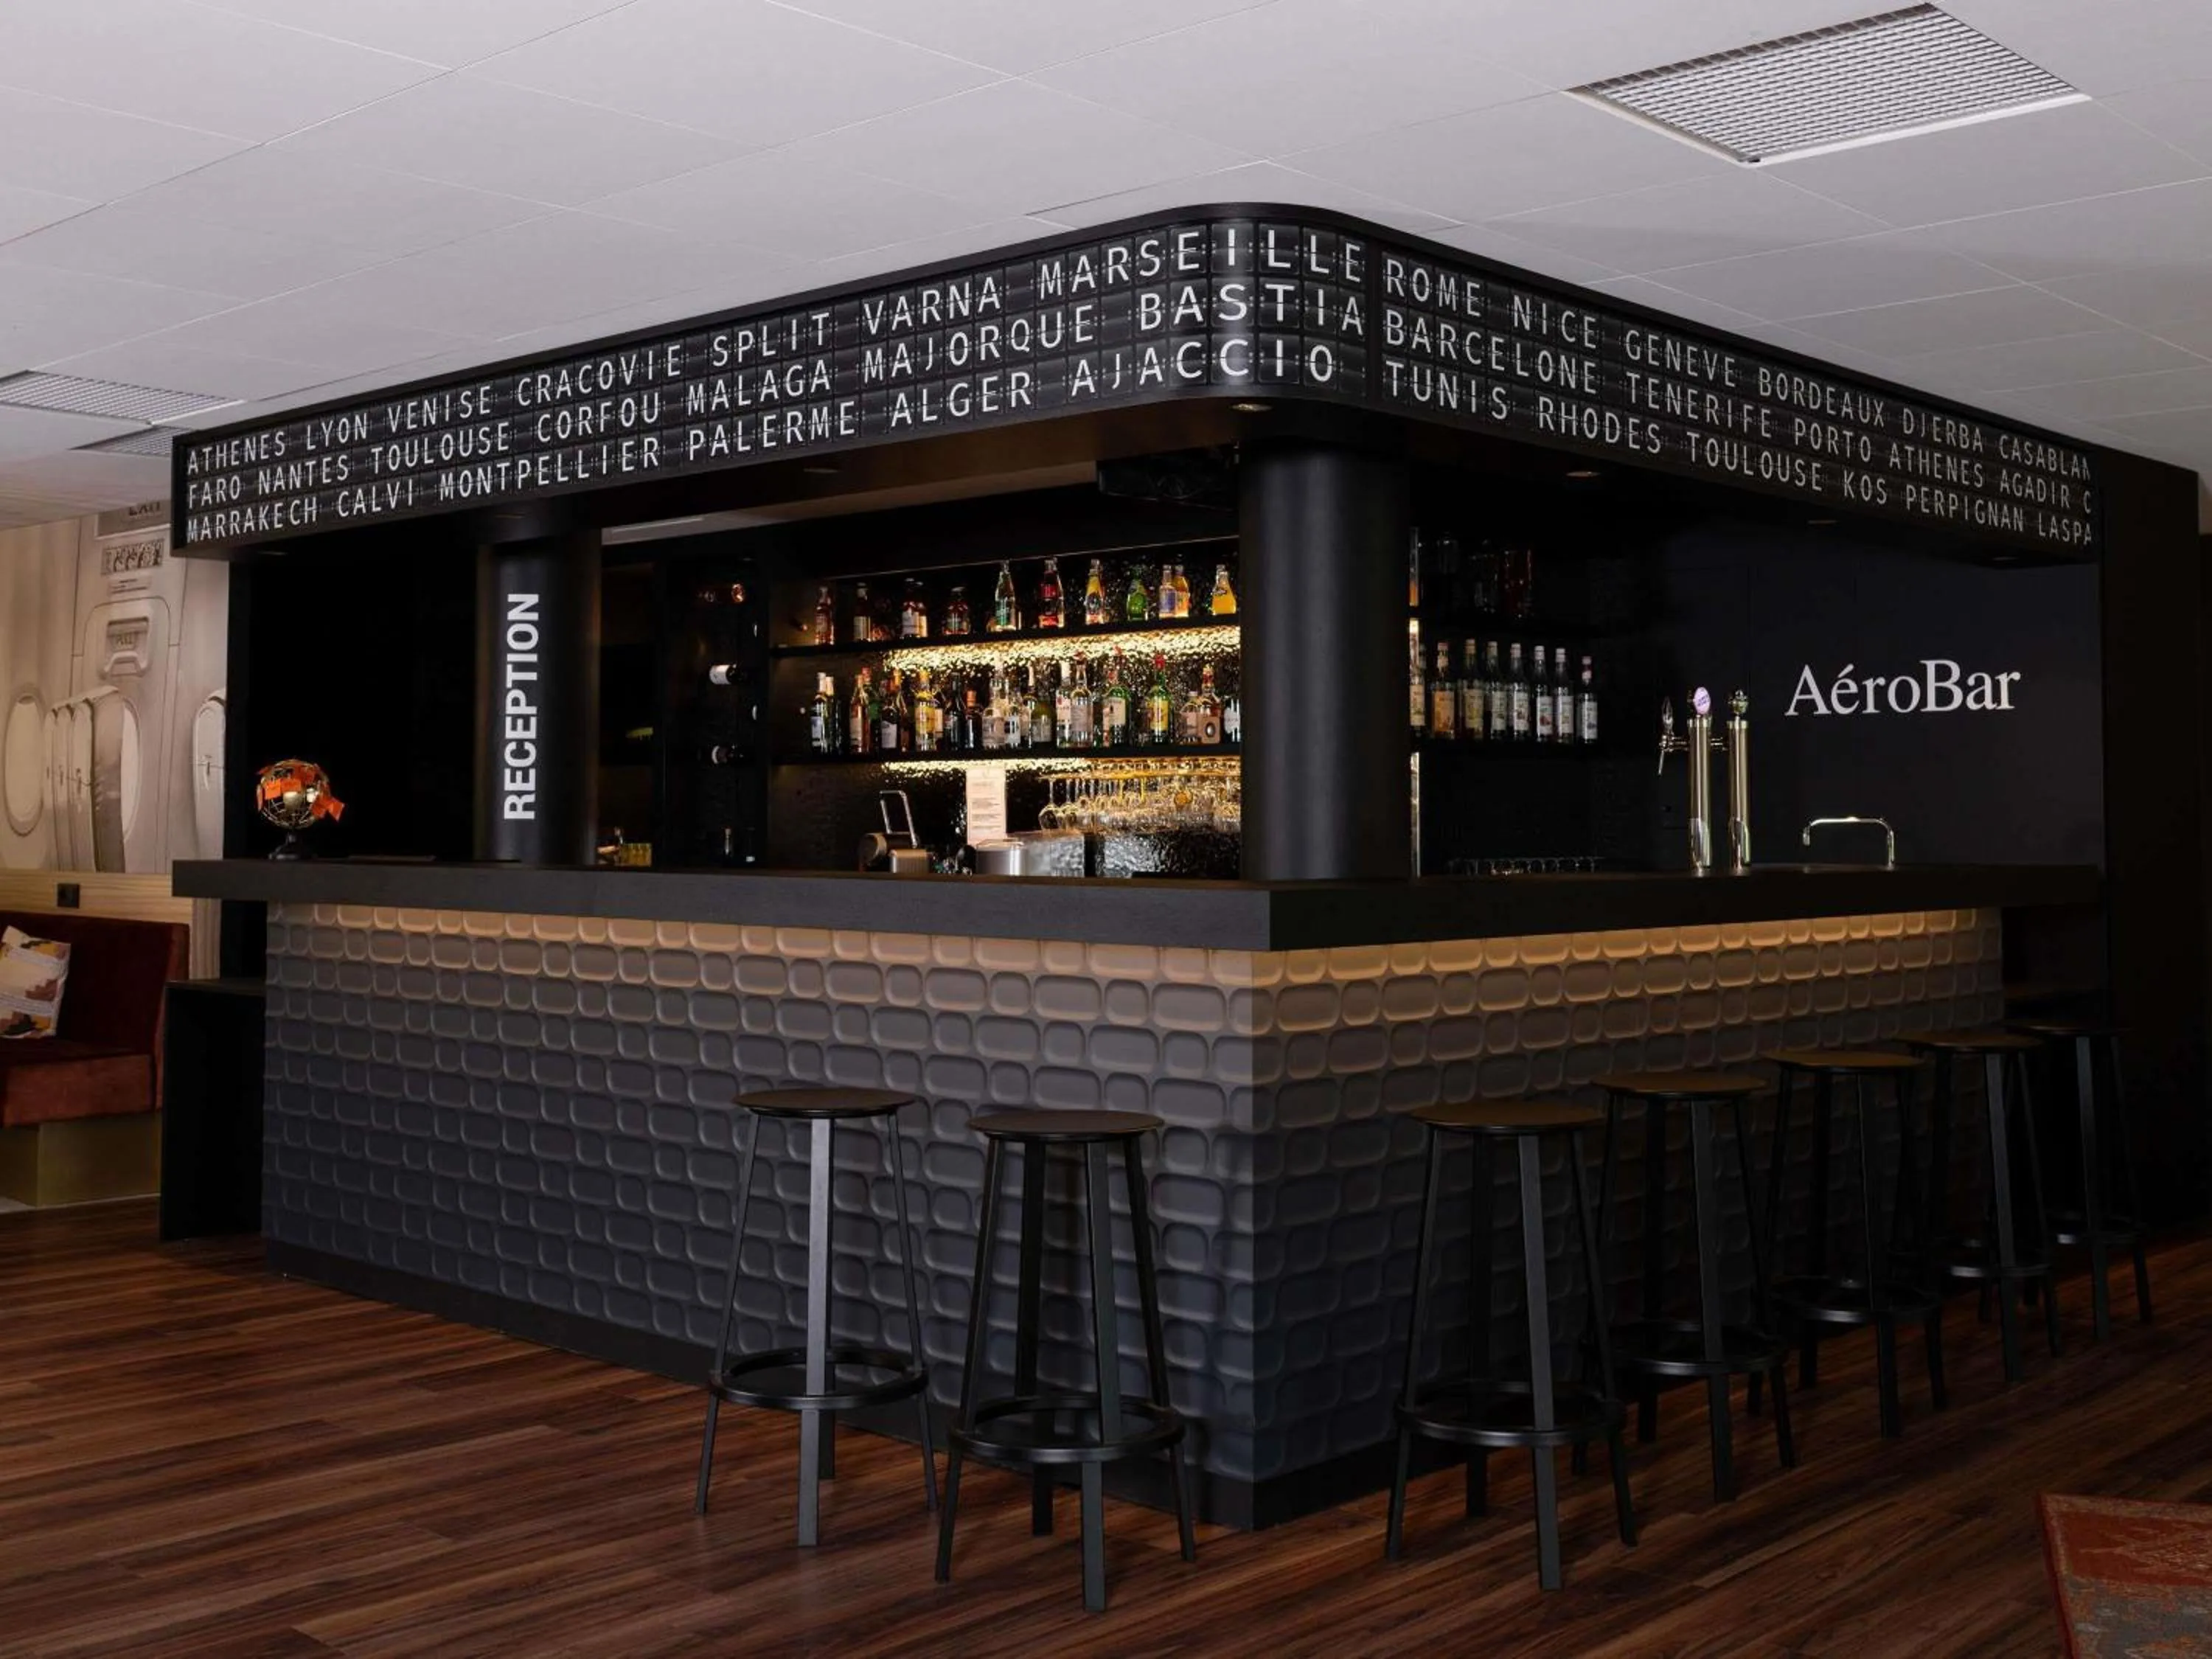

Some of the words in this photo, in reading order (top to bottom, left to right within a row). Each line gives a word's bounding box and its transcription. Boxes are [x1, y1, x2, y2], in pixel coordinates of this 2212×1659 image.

[187, 431, 285, 475] ATHENES
[306, 413, 367, 451] LYON
[388, 386, 491, 433] VENISE
[518, 345, 681, 406] CRACOVIE
[714, 313, 829, 366] SPLIT
[863, 276, 1001, 335] VARNA
[1041, 229, 1361, 300] MARSEILLE
[187, 497, 317, 543] MARRAKECH
[338, 479, 412, 517] CALVI
[441, 437, 658, 501] MONTPELLIER
[689, 401, 855, 461] PALERME
[891, 372, 1031, 428] ALGER
[1071, 338, 1333, 397] AJACCIO
[189, 476, 240, 509] FARO
[258, 455, 349, 496] NANTES
[372, 422, 509, 474] TOULOUSE
[538, 392, 658, 442] CORFOU
[688, 359, 830, 416] MALAGA
[864, 305, 1093, 383] MAJORQUE
[1141, 284, 1363, 336] BASTIA
[1386, 361, 1508, 420] TUNIS
[1540, 396, 1661, 453] RHODES
[1687, 432, 1822, 491] TOULOUSE
[1844, 470, 1887, 505] KOS
[1907, 484, 2023, 532] PERPIGNAN
[2039, 513, 2091, 545] LASPA
[1387, 260, 1480, 316] ROME
[1514, 296, 1596, 349] NICE
[1626, 330, 1735, 387] GENEVE
[1759, 368, 1885, 427] BORDEAUX
[1904, 408, 1983, 453] DJERBA
[1387, 310, 1596, 394] BARCELONE
[1626, 372, 1770, 437] TENERIFE
[1795, 418, 1871, 462] PORTO
[1890, 443, 1983, 487] ATHENES
[2000, 469, 2070, 509] AGADIR
[504, 594, 539, 820] RECEPTION
[1784, 659, 2021, 716] AéroBar
